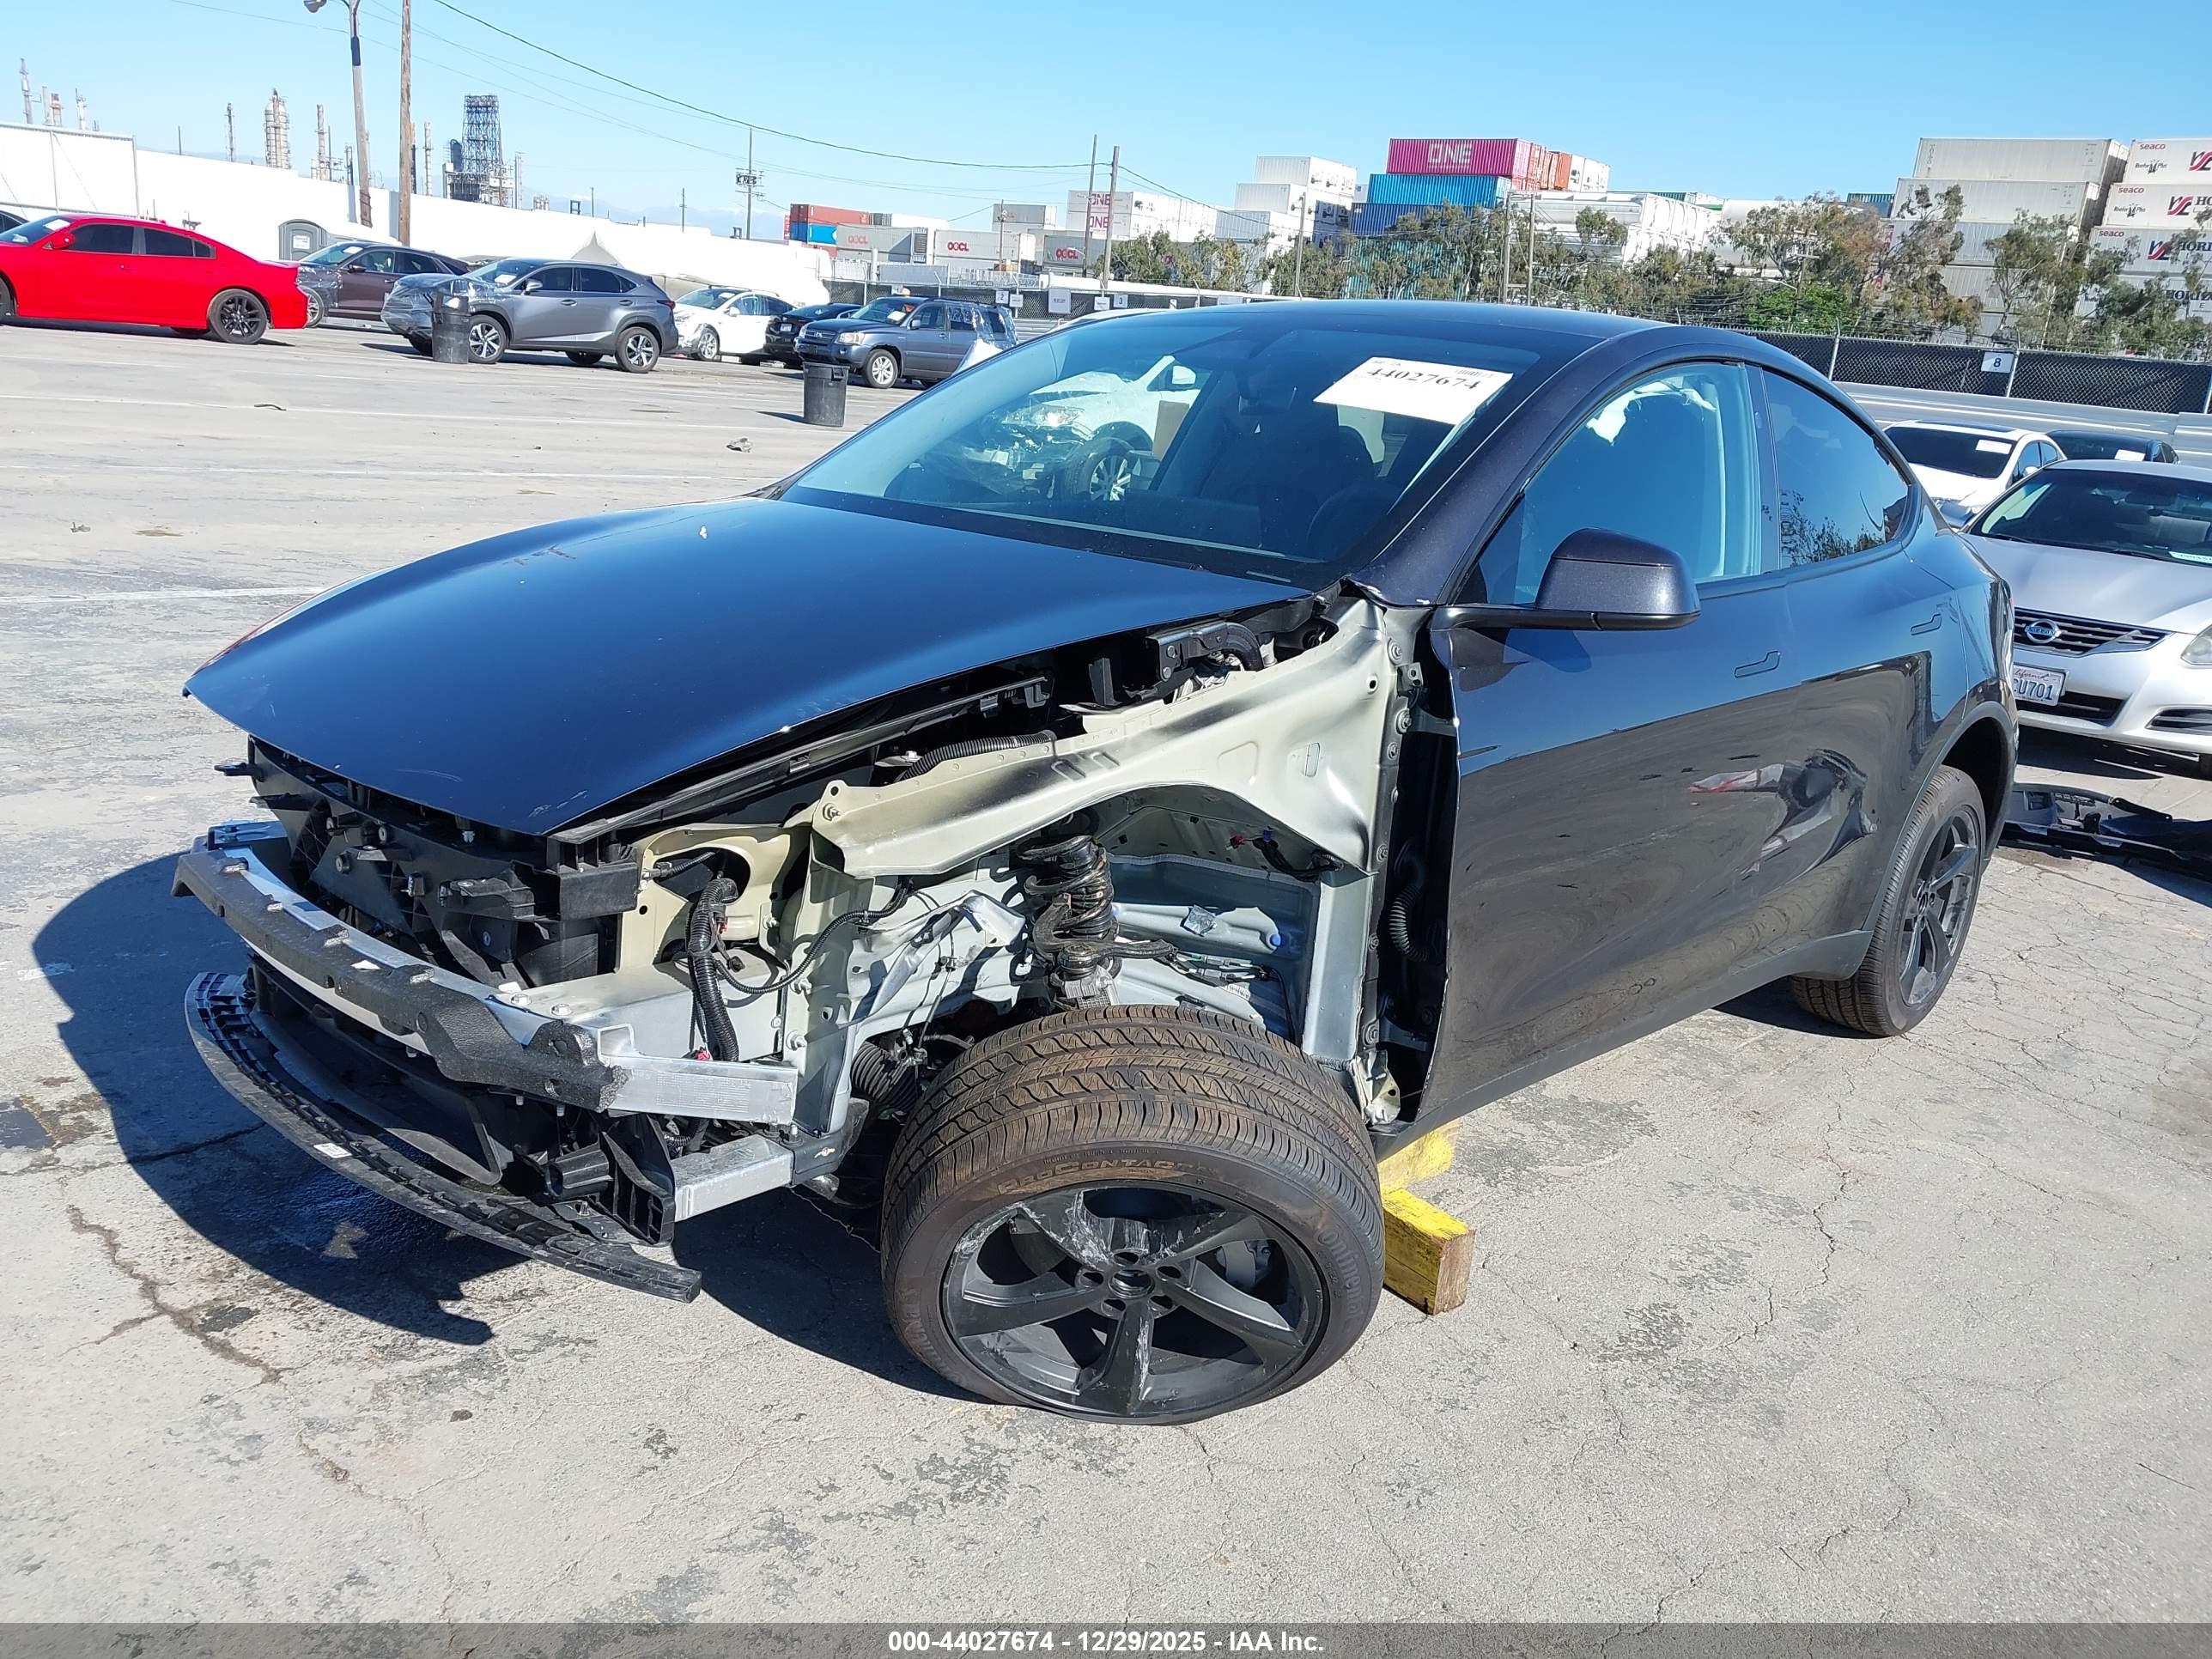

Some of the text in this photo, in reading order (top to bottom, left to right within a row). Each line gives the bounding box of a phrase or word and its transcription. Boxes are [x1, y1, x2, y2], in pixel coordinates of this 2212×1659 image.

[1428, 143, 1471, 163] ONE
[947, 241, 969, 252] OOCL
[1993, 357, 2002, 368] 8
[1366, 368, 1480, 390] 44027674
